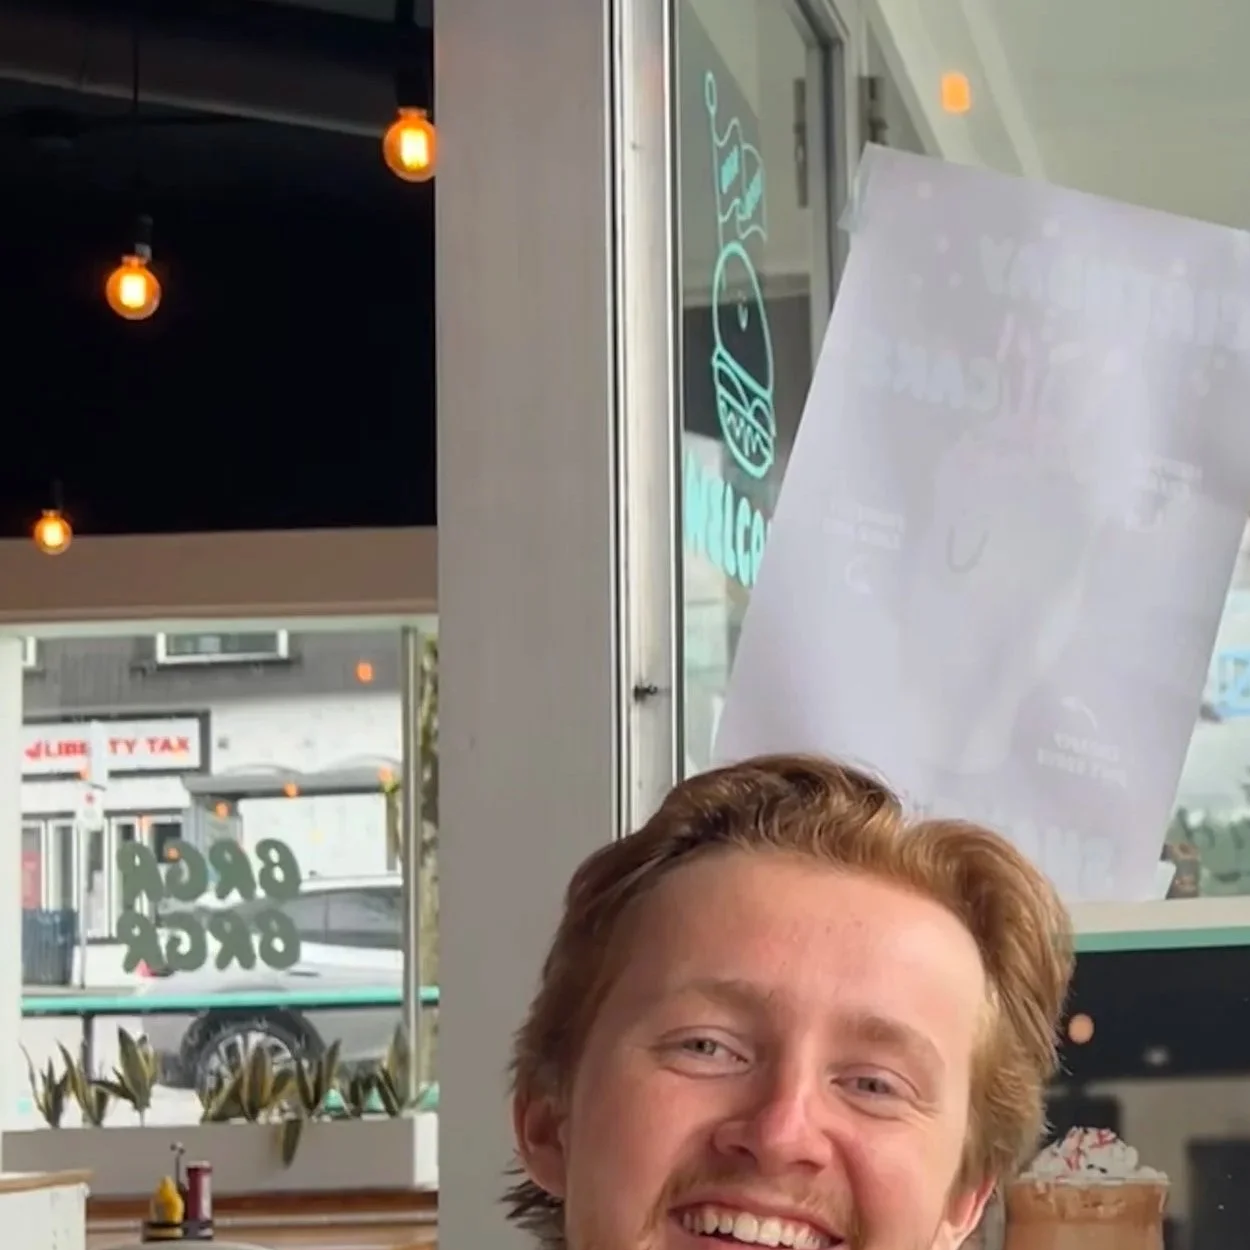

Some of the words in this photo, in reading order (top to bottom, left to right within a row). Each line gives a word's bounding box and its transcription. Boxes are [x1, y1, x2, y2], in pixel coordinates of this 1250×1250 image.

[685, 450, 772, 588] WELCO
[45, 738, 137, 757] LIBETY
[147, 736, 190, 753] TAX
